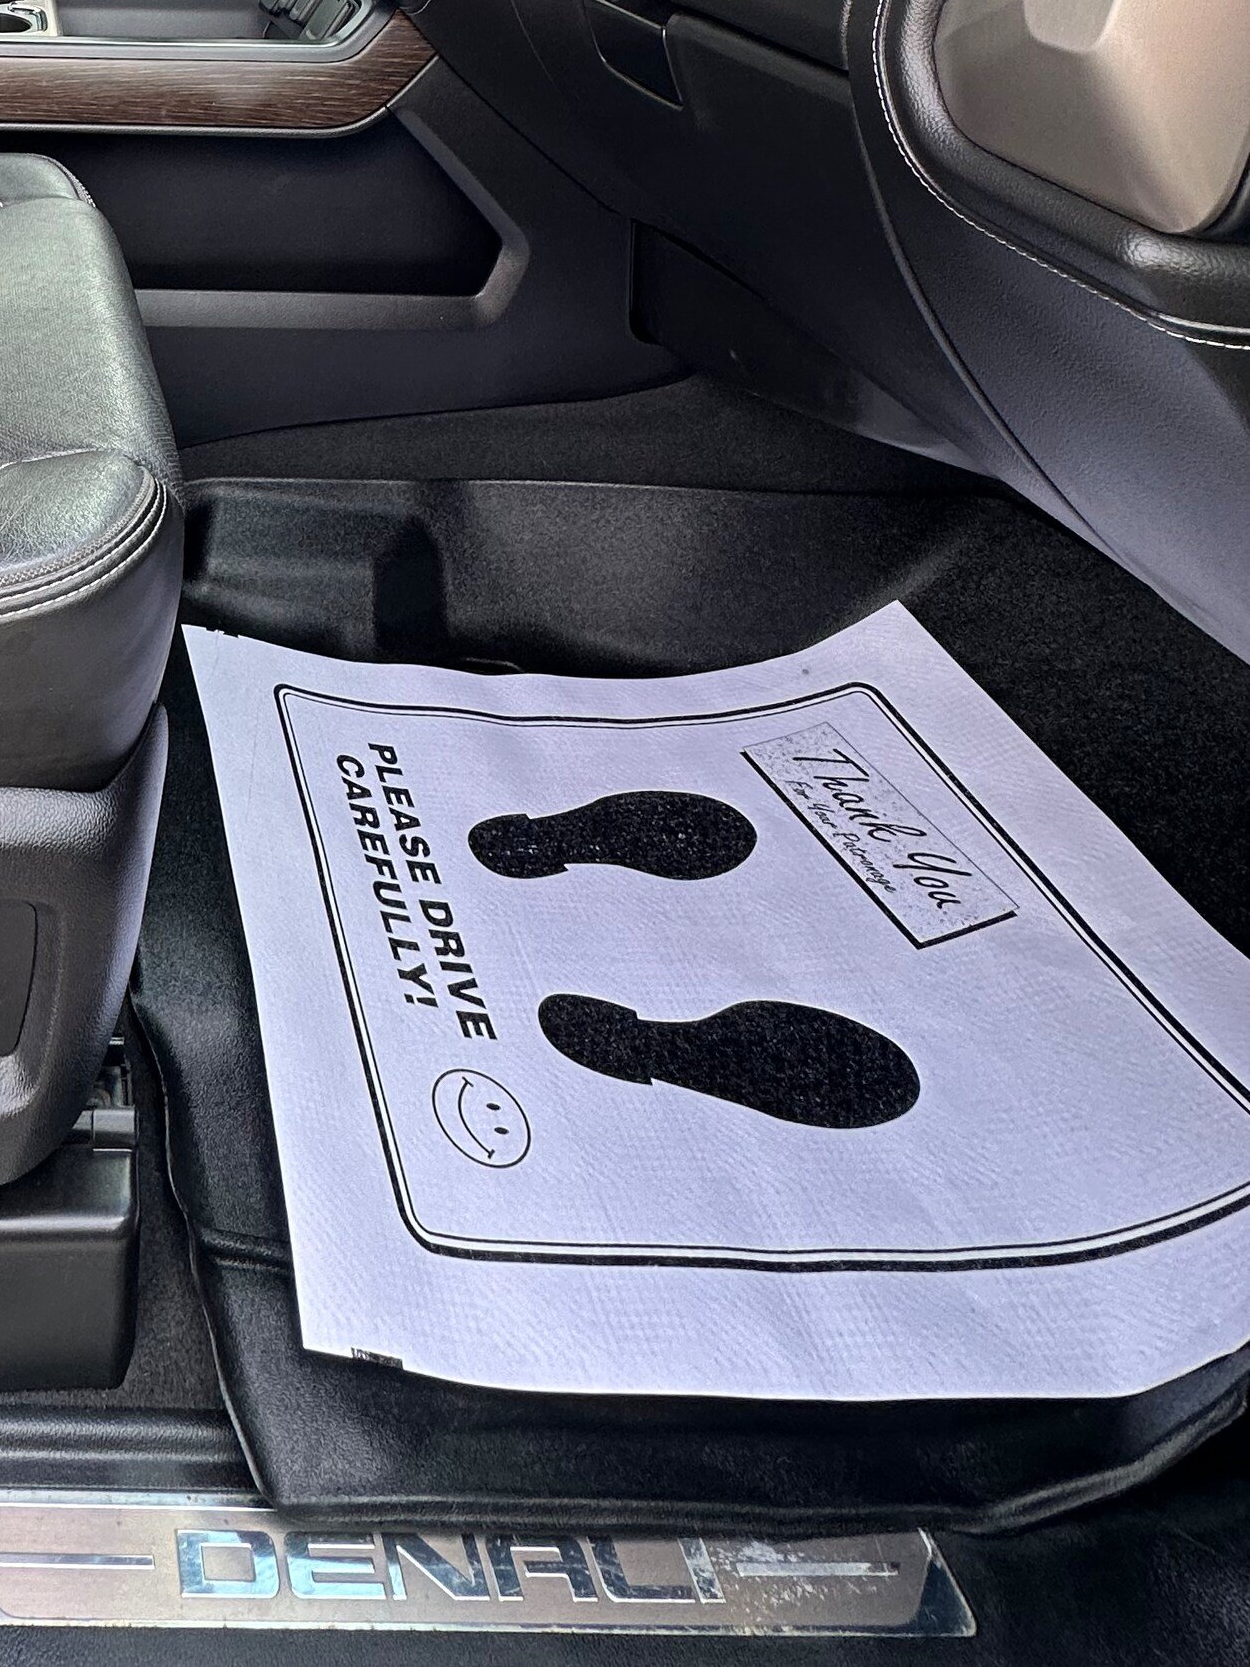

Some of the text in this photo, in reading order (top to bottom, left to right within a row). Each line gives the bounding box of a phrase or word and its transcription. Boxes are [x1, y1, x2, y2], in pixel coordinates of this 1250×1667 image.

[336, 754, 439, 1008] CAREFULLY!
[368, 742, 498, 1040] PLEASE DRIVE
[784, 780, 897, 894] For Your Patronage
[792, 748, 973, 910] Thank You
[176, 1530, 726, 1604] DENALI
